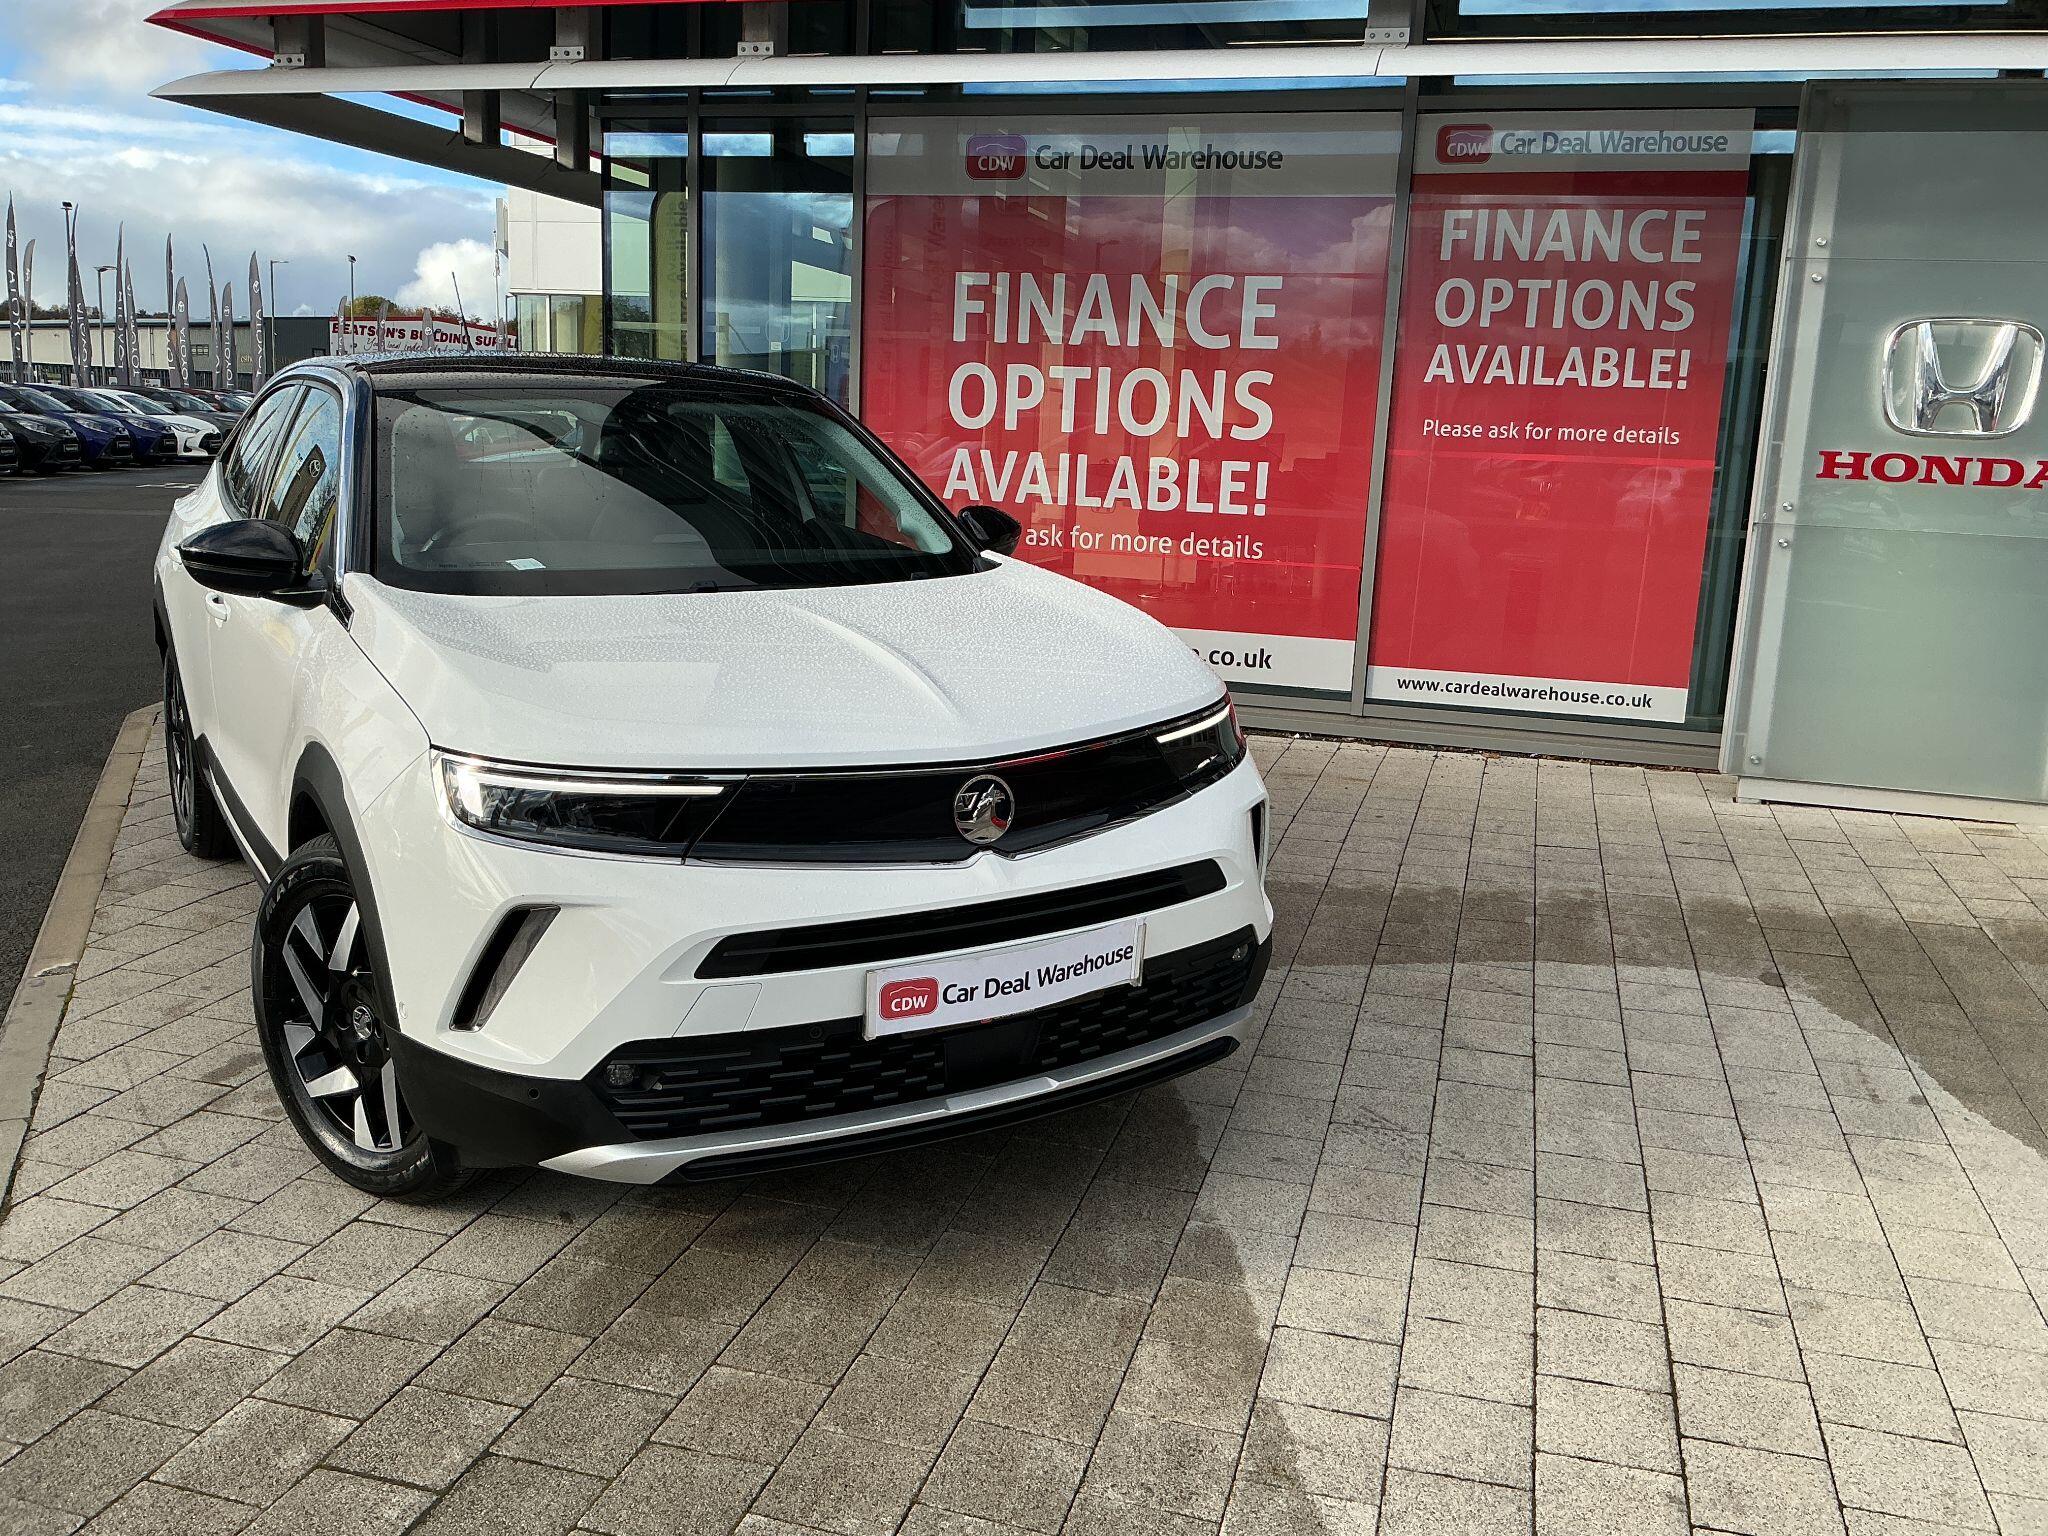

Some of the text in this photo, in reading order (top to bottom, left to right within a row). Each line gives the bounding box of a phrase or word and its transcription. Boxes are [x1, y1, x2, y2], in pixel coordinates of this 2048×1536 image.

[977, 144, 1284, 171] CDW Car Deal Warehouse
[1447, 130, 1728, 157] CDW Car Deal Warehouse
[1440, 208, 1707, 263] FINANCE
[953, 272, 1283, 350] FINANCE
[1434, 277, 1697, 332] OPTIONS
[179, 327, 189, 386] TOYOTA
[332, 322, 406, 339] BEATSN'S
[410, 329, 470, 344] BLDING
[1424, 343, 1691, 390] AVAILABLE!
[948, 362, 1274, 441] OPTIONS
[1423, 419, 1680, 445] Please ask for more details
[943, 448, 1269, 516] AVAILABLE!
[1026, 525, 1264, 559] ask for more details
[1192, 648, 1273, 669] .co.uk
[1397, 678, 1652, 708] www.cardealwarehouse.co.uk
[891, 945, 1134, 1012] CDW Car Deal Warehouse
